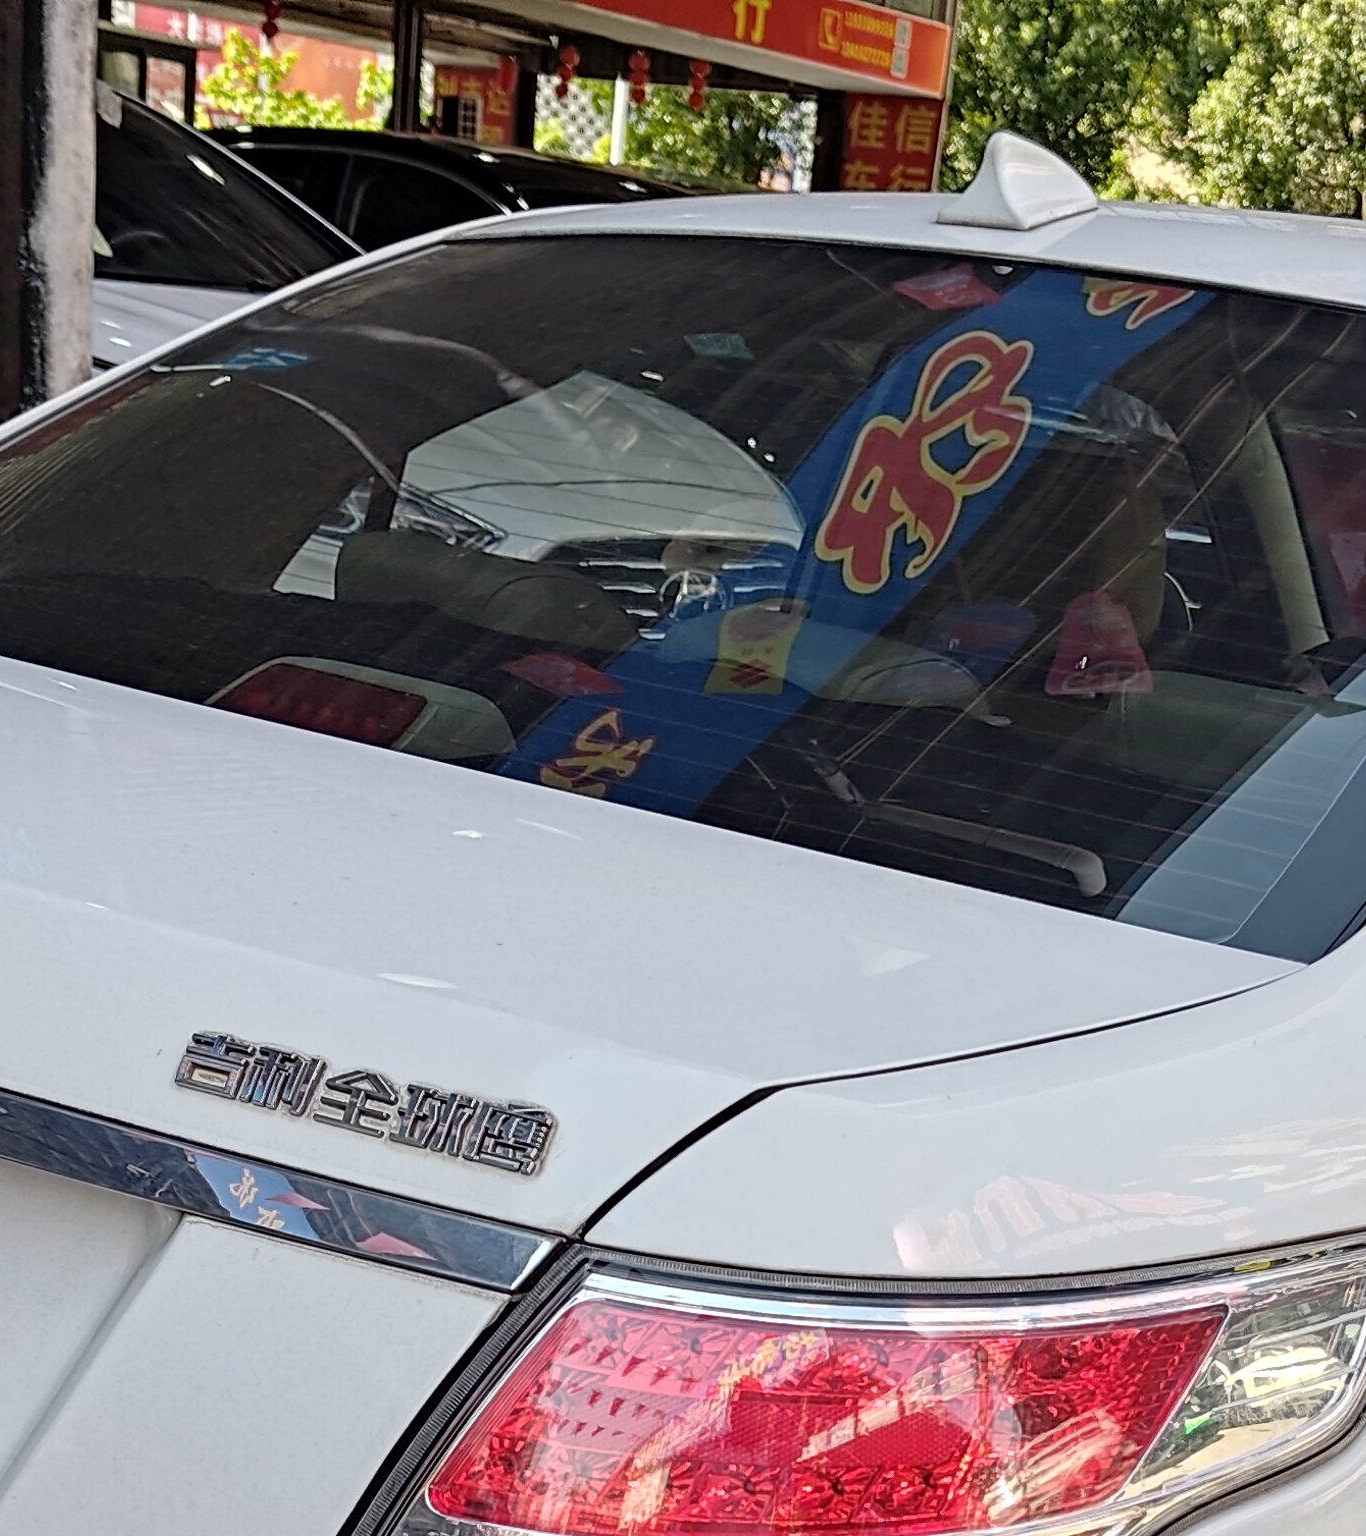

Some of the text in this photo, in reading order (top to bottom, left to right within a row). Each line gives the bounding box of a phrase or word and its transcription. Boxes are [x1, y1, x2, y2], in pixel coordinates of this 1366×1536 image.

[849, 101, 936, 153] 佳信
[174, 1031, 554, 1176] 吉利全球鹰
